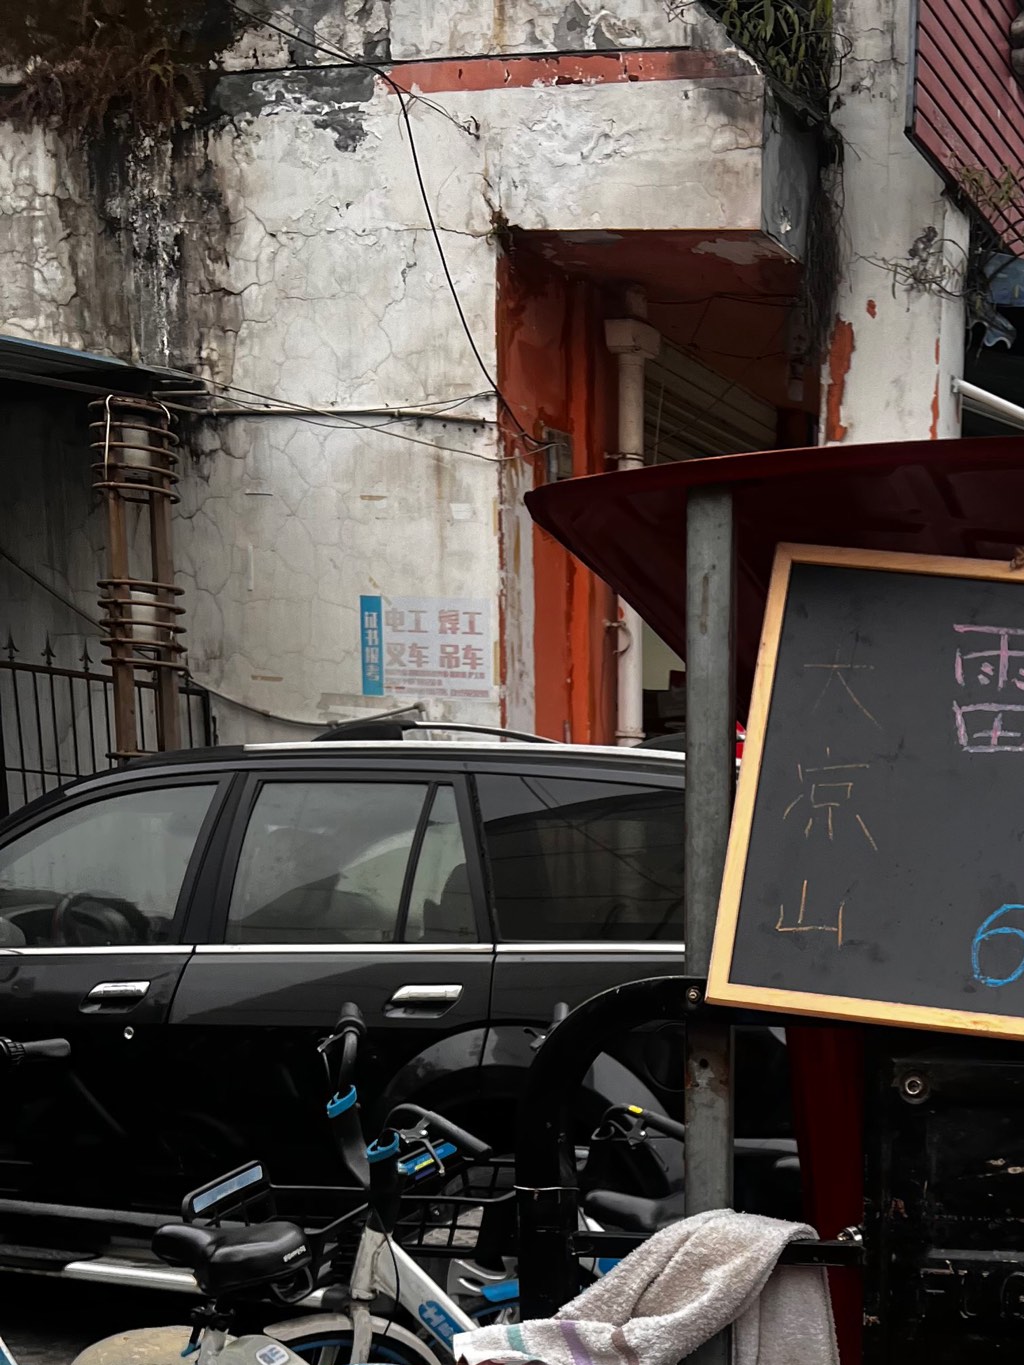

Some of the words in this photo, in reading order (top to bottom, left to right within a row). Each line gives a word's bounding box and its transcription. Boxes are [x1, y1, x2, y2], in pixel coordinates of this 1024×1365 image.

[385, 608, 429, 633] 电工
[438, 609, 484, 635] 焊工
[386, 643, 430, 668] 叉车
[439, 644, 484, 670] 吊车
